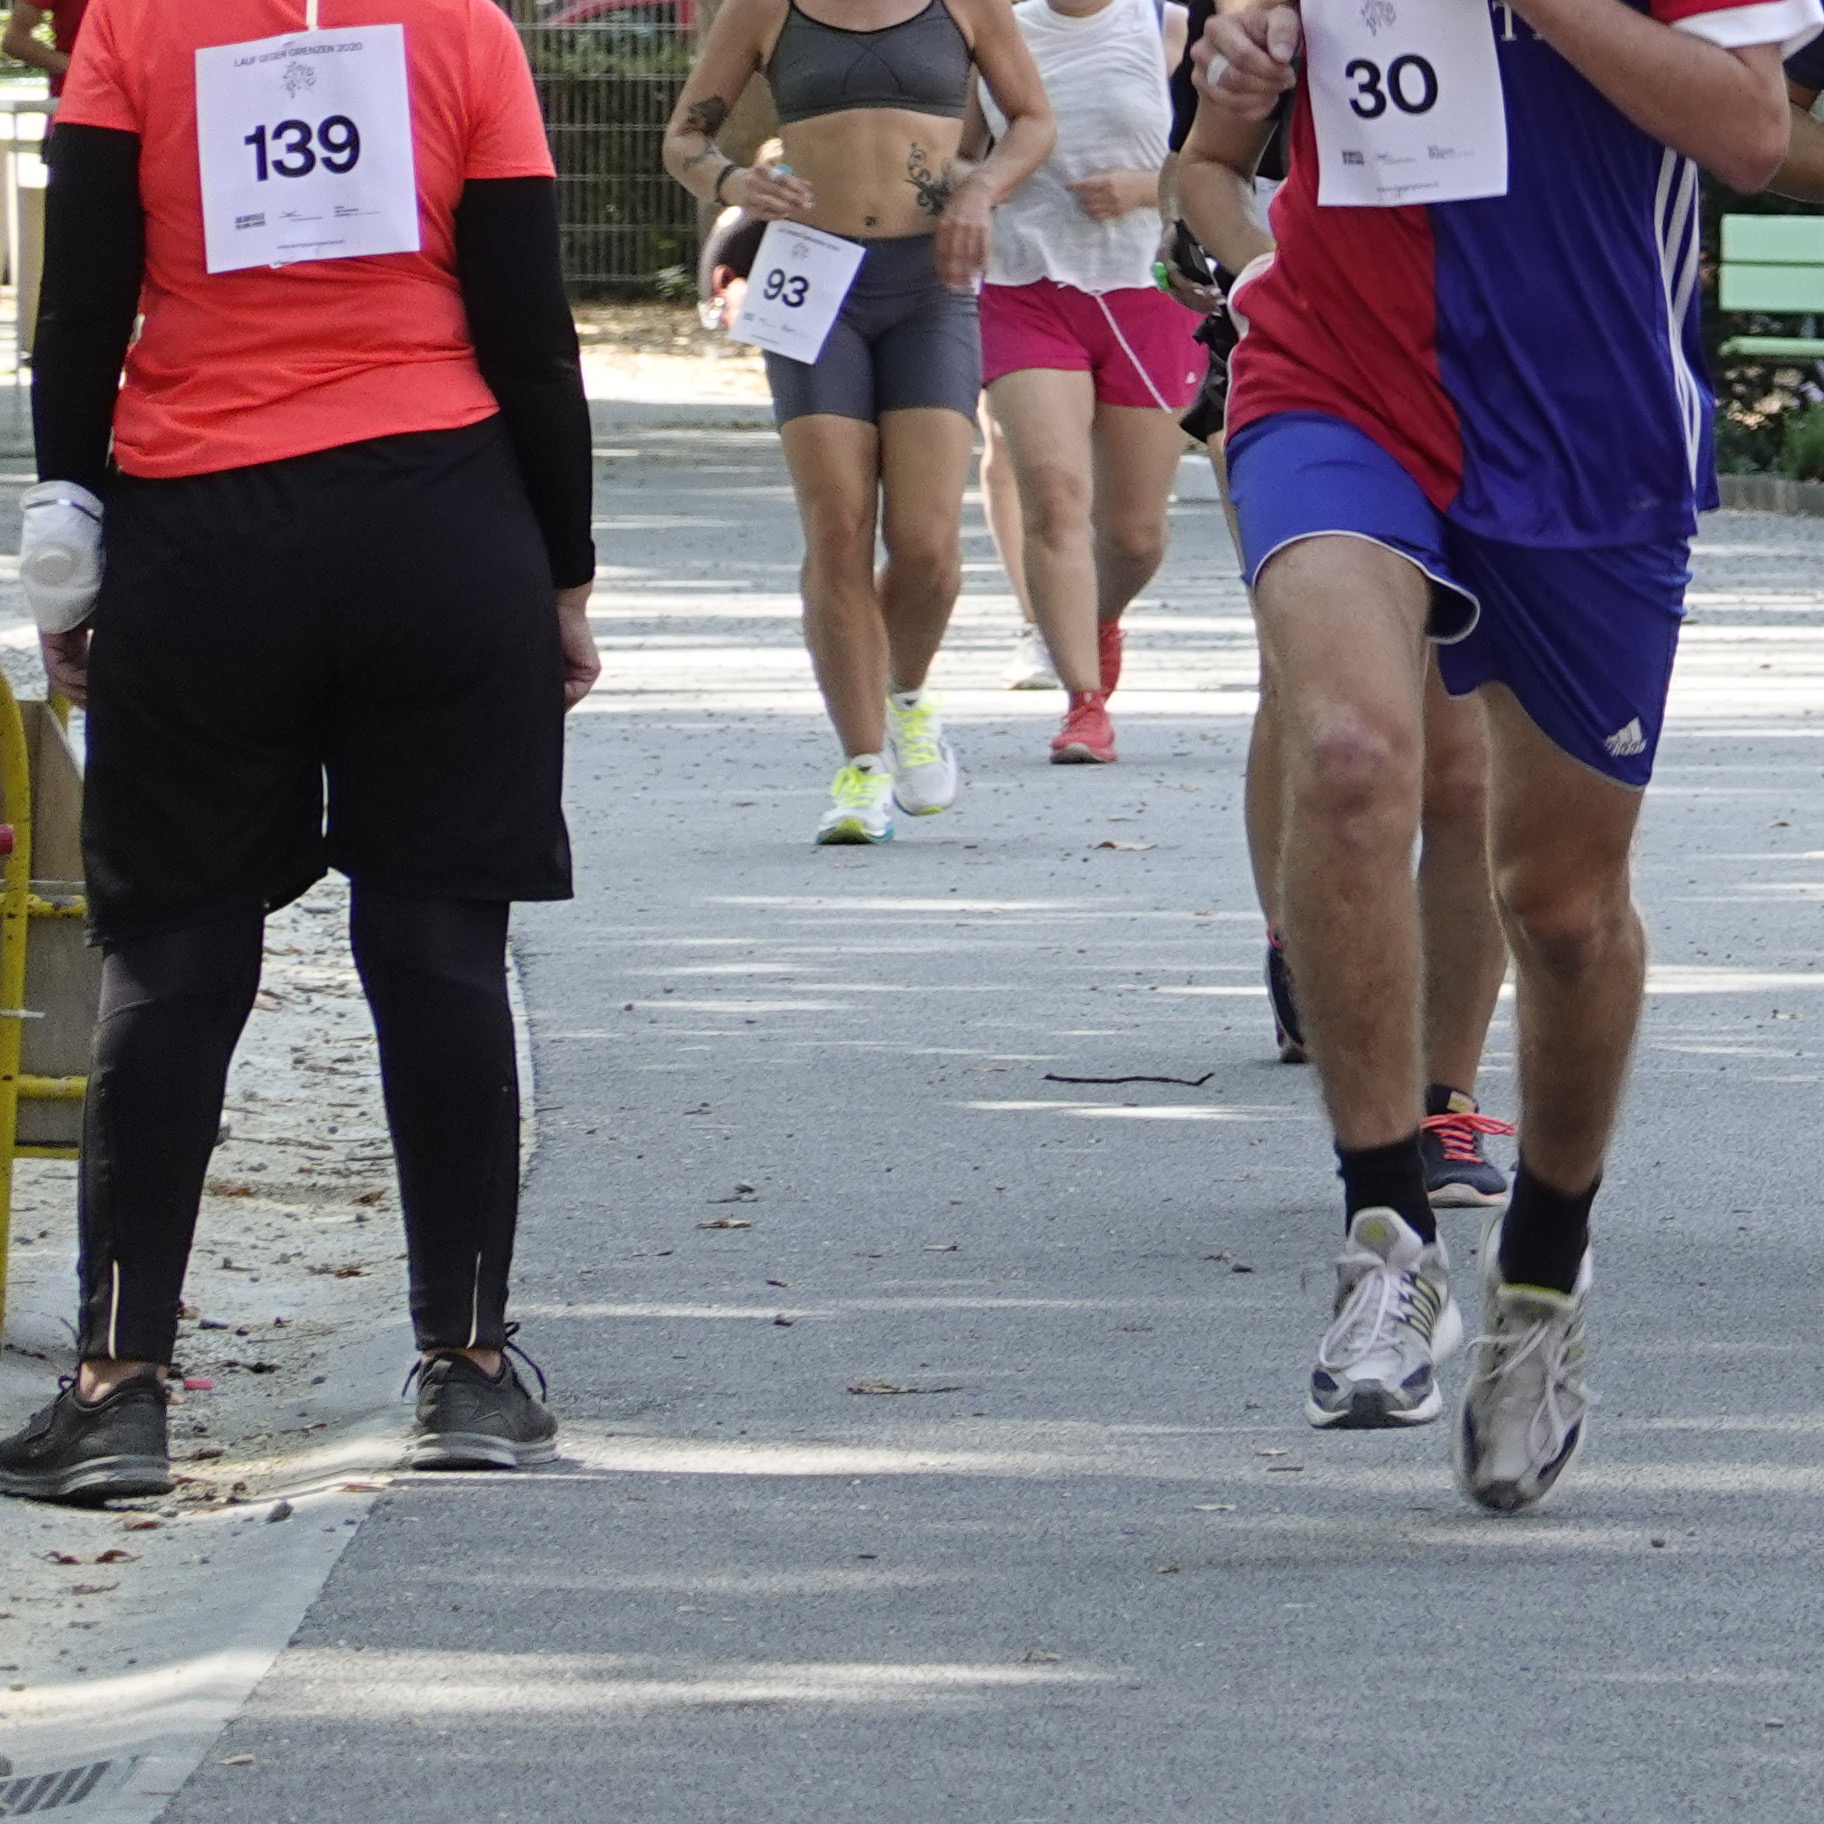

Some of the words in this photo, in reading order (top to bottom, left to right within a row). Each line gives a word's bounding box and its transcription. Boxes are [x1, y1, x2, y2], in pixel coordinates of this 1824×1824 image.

[234, 56, 257, 68] LAUF
[288, 44, 335, 57] GRENZEN
[336, 41, 363, 53] 2020
[1344, 53, 1439, 119] 30
[244, 114, 361, 182] 139
[763, 268, 810, 308] 93
